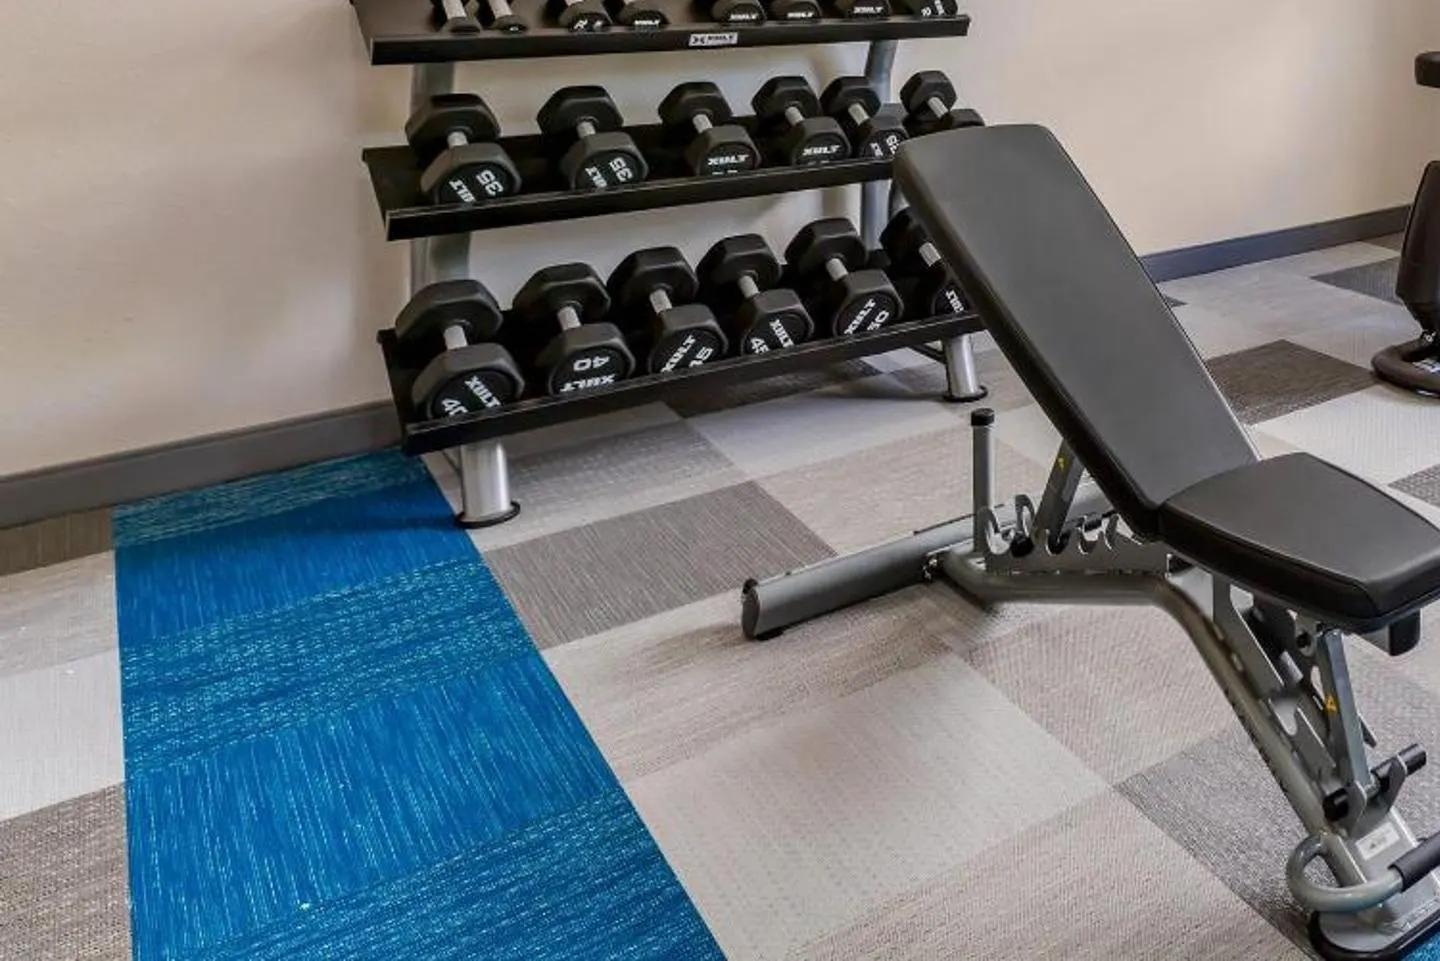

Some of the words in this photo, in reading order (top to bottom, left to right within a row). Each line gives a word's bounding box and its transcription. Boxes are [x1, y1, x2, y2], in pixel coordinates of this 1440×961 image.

[475, 169, 504, 196] 35
[609, 157, 633, 182] 35
[769, 319, 795, 348] XULT
[573, 356, 610, 372] 40
[464, 375, 500, 408] XULT
